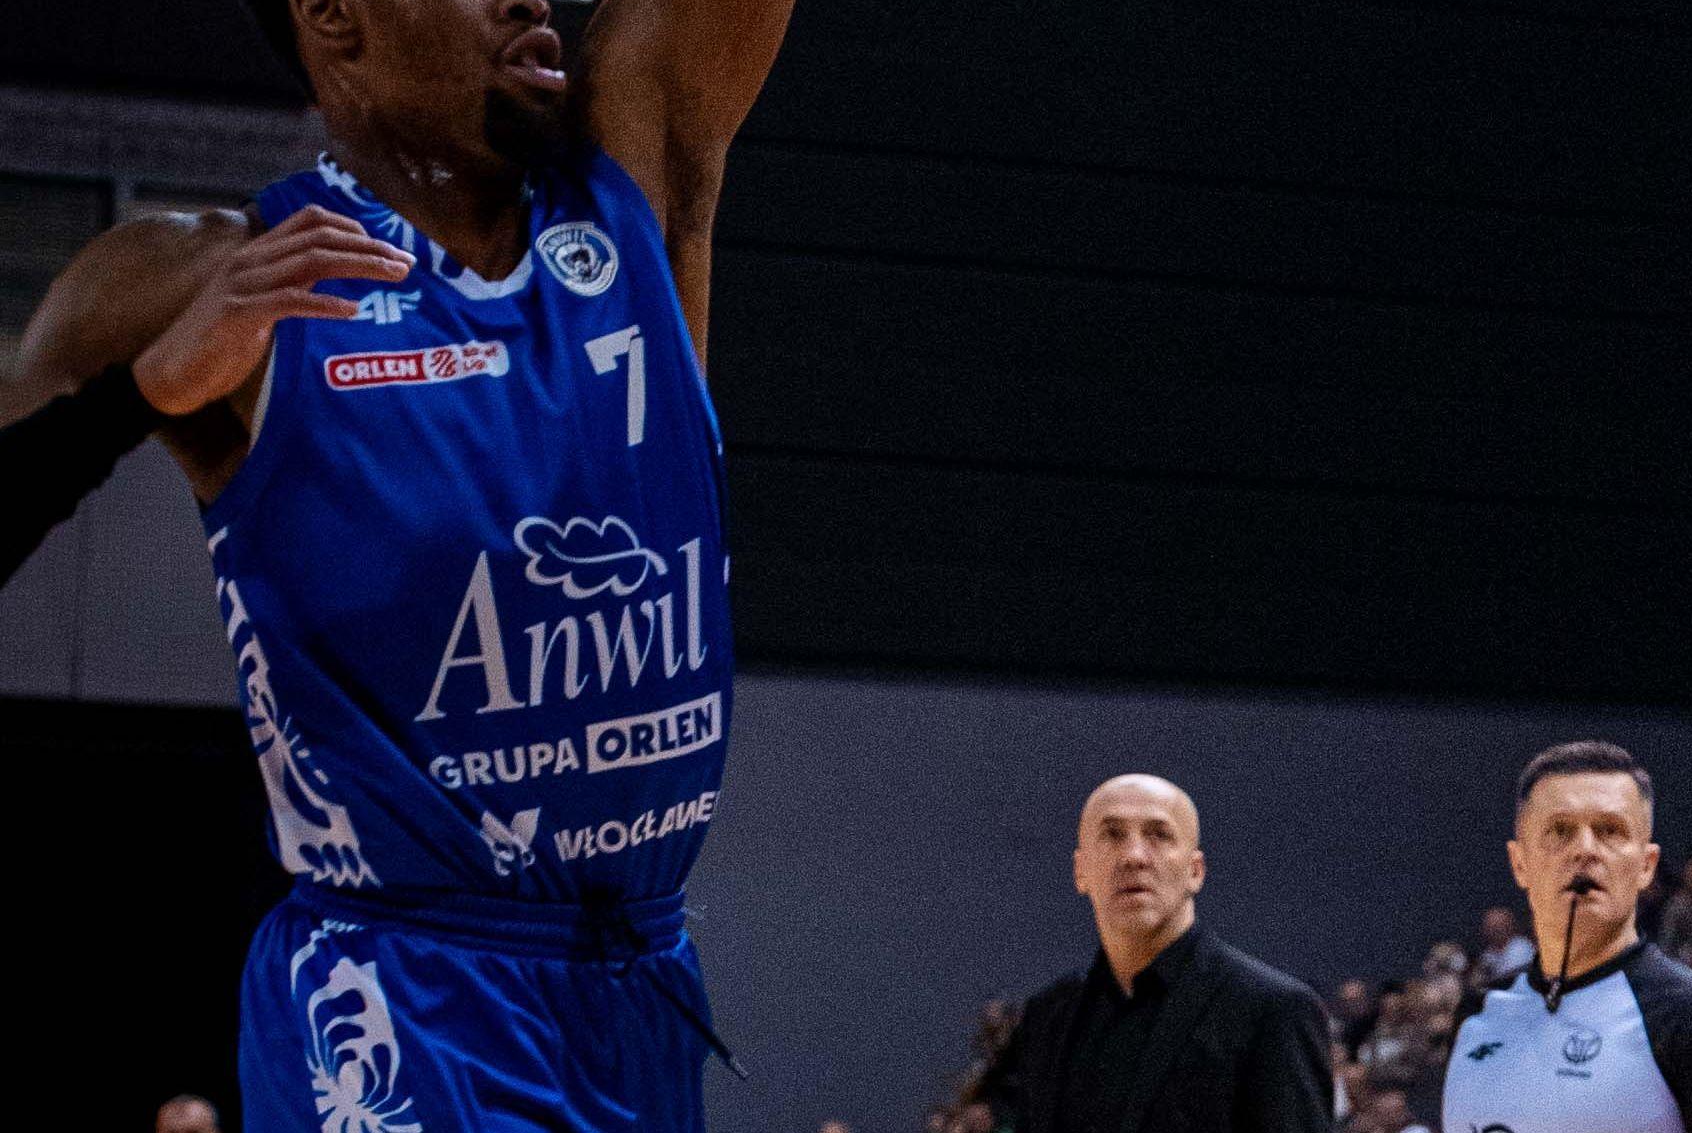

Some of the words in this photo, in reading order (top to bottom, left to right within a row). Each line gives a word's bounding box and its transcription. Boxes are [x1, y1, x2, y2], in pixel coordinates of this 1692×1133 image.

[335, 358, 419, 383] ORLEN
[584, 325, 645, 446] 7
[414, 537, 709, 722] Anwil
[429, 737, 581, 789] GRUPA
[597, 701, 713, 762] ORLEN
[554, 790, 720, 863] WŁOCŁAWE
